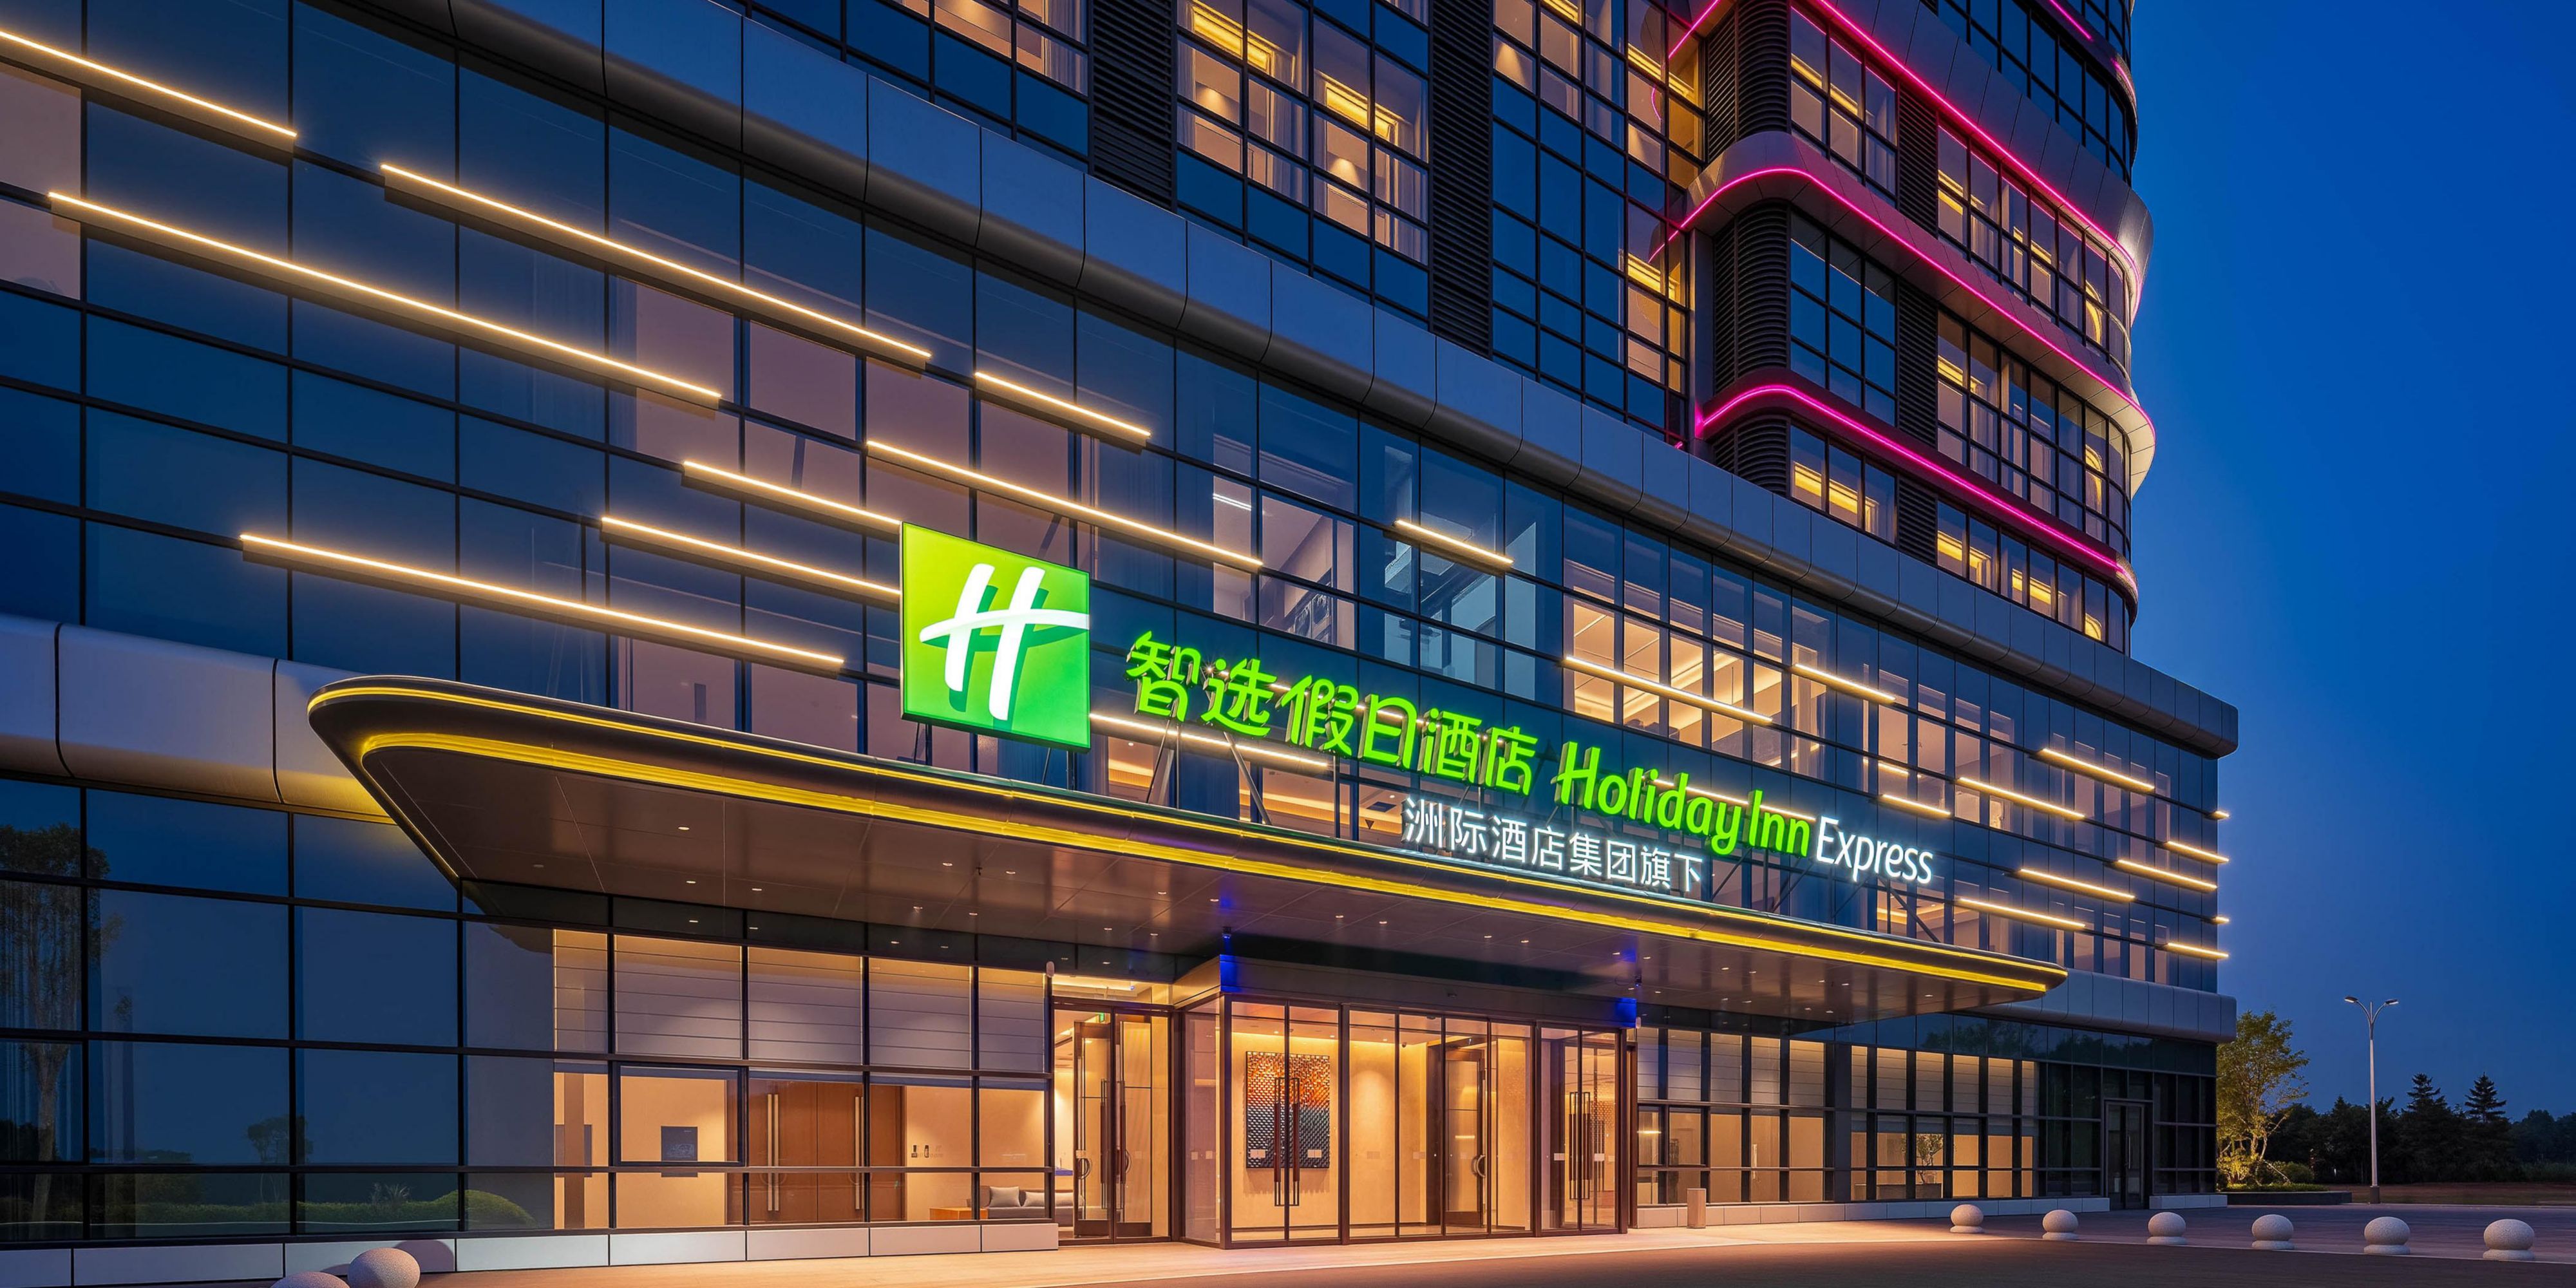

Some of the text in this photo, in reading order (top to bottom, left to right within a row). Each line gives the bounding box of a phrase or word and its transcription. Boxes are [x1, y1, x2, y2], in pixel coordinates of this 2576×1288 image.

[1126, 630, 1538, 796] 智选假日酒店
[1405, 797, 1703, 892] 洲际酒店集团旗下
[1555, 741, 1934, 884] Holiday Inn Express
